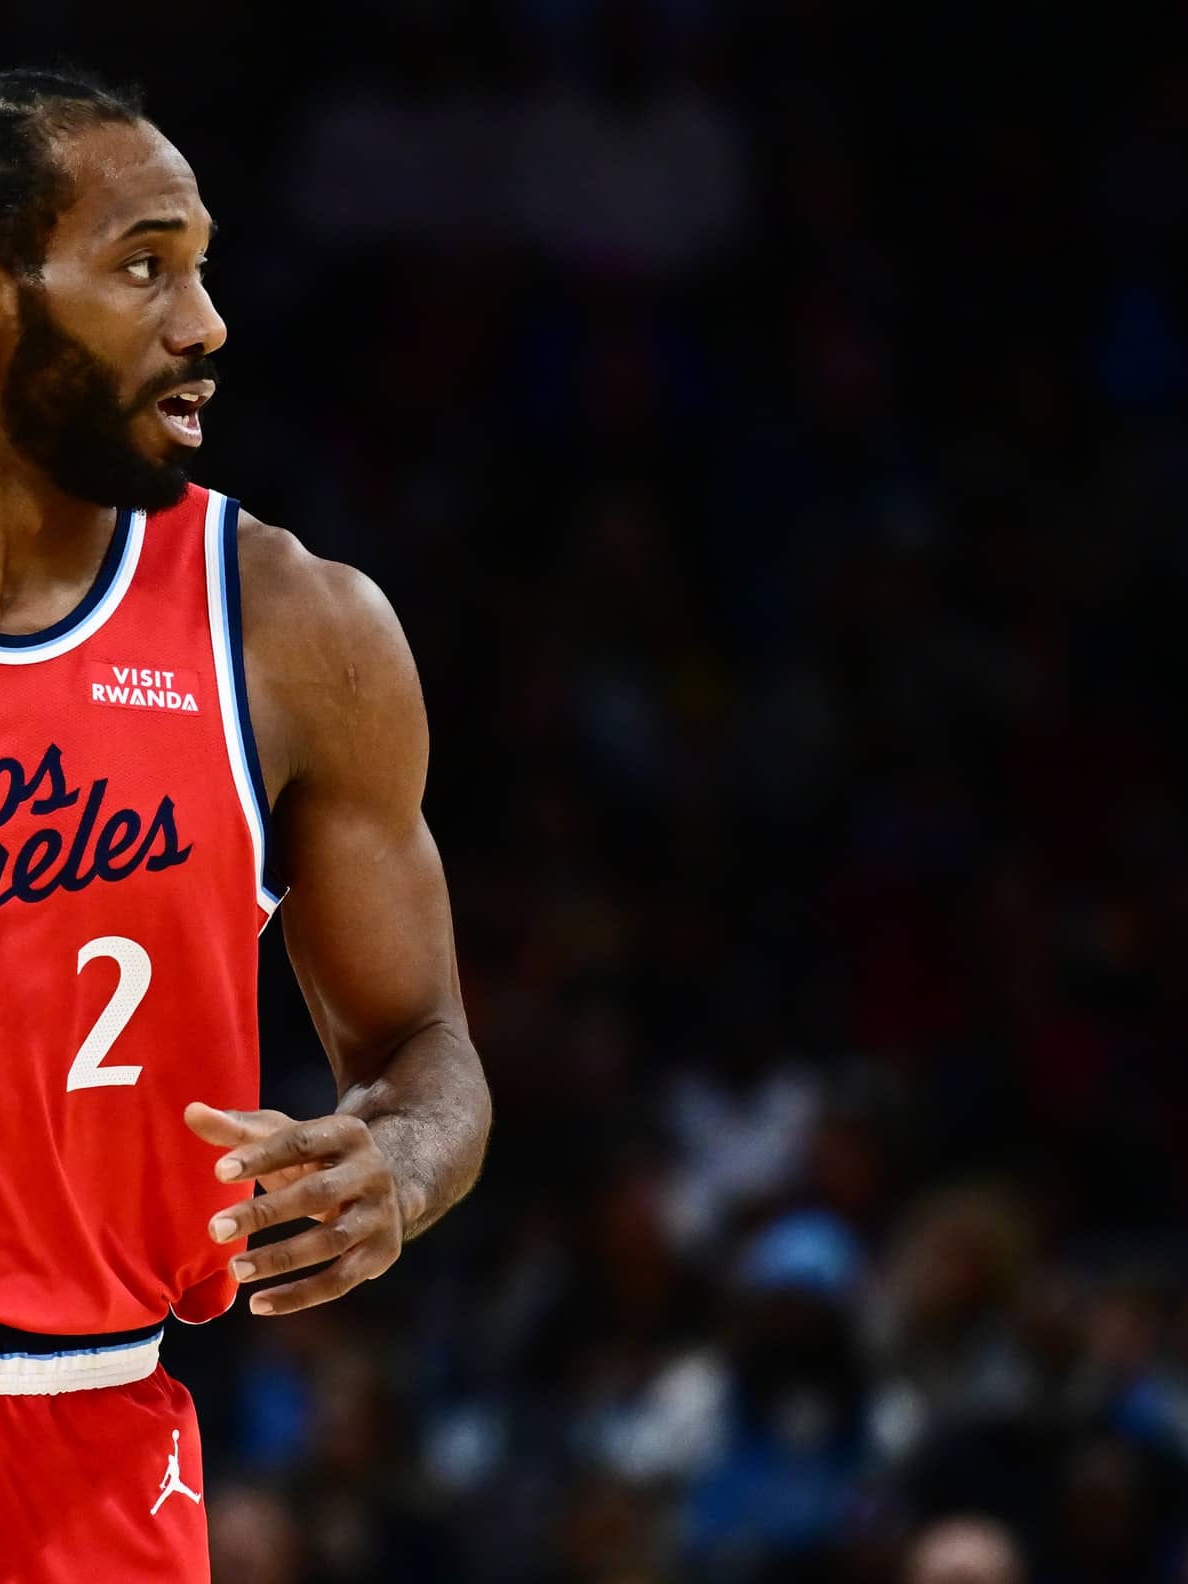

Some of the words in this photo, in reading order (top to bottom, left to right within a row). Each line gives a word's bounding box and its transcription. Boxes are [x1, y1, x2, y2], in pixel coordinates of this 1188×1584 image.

[112, 666, 174, 689] VISIT
[91, 683, 199, 711] RWANDA
[66, 936, 152, 1092] 2
